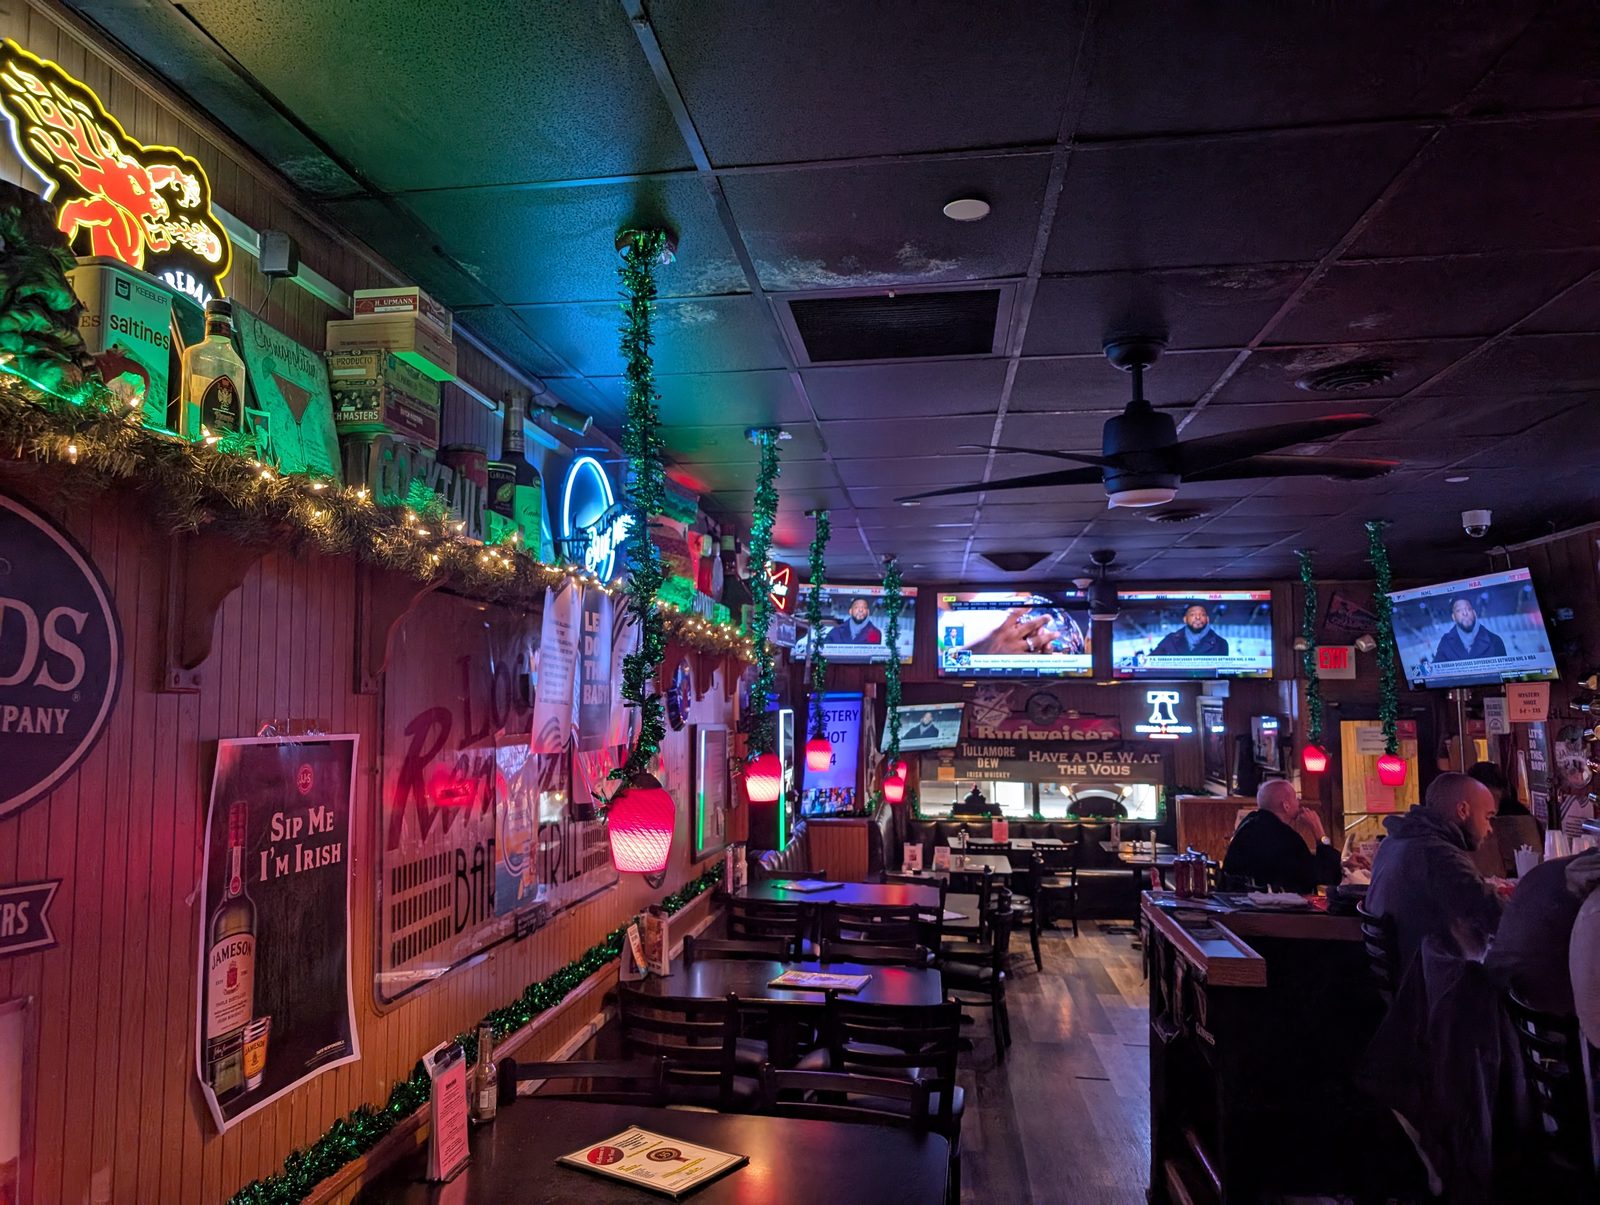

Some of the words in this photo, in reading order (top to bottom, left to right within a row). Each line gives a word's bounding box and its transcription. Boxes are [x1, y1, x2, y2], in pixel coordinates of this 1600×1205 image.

[135, 285, 169, 306] KEEBLER
[383, 298, 413, 306] UPMANN
[109, 314, 169, 350] saltines
[336, 356, 373, 366] PRODUCTO
[343, 411, 379, 421] MASTERS
[1319, 646, 1349, 670] EXIT
[0, 704, 70, 734] PANY
[961, 742, 1016, 757] TULLAMORE
[977, 758, 999, 769] DEW
[1029, 751, 1068, 763] HAVE
[1071, 753, 1081, 763] A
[1086, 751, 1137, 764] D.E.W.
[1141, 753, 1160, 764] AT
[966, 771, 983, 779] IRISH
[984, 771, 1011, 779] WHISKEY
[1057, 763, 1087, 776] THE
[1092, 763, 1131, 776] VOUS
[271, 811, 303, 842] SIP
[308, 805, 335, 836] ME
[259, 846, 289, 882] I'M
[295, 842, 342, 873] IRISH
[211, 940, 252, 970] JAMESON
[244, 1040, 266, 1056] JAMESON
